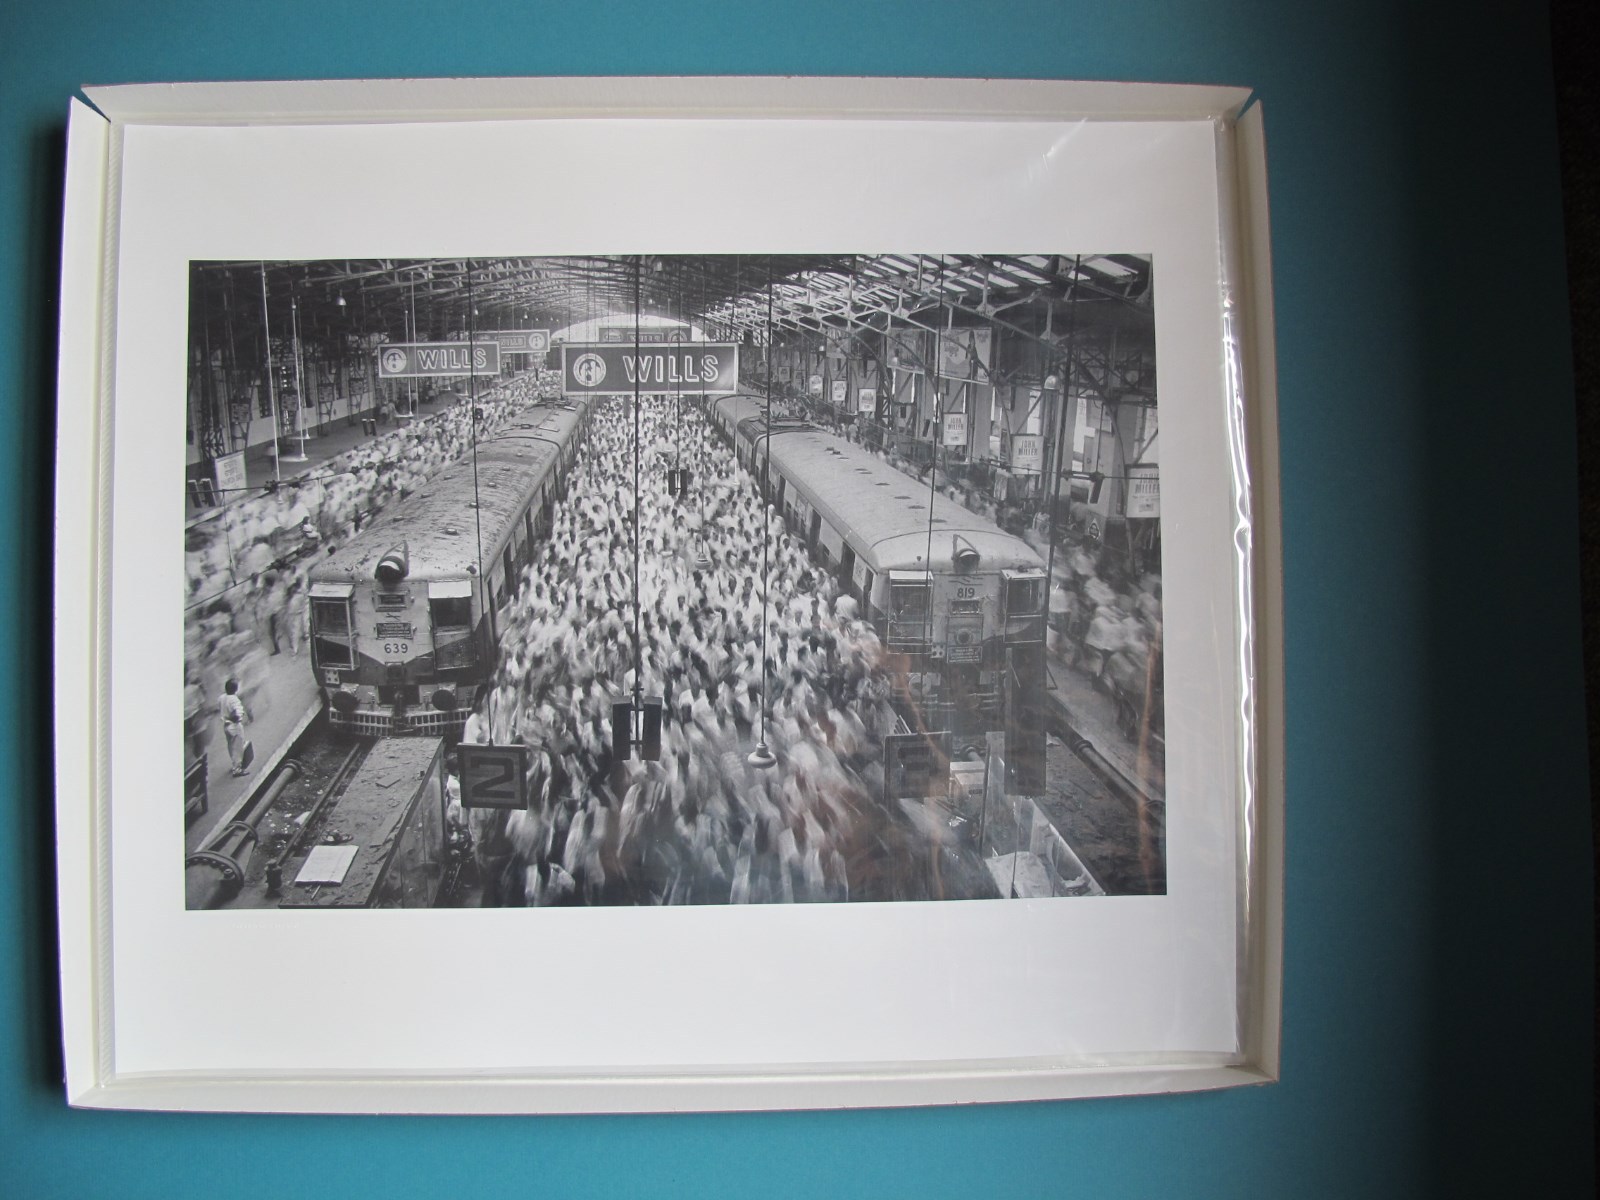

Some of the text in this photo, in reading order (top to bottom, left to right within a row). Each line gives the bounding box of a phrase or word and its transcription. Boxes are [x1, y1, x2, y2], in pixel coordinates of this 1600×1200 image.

[417, 348, 487, 369] WILLS
[622, 354, 719, 383] WILLS
[956, 587, 975, 599] 819
[384, 643, 409, 654] 639
[470, 756, 516, 800] 2
